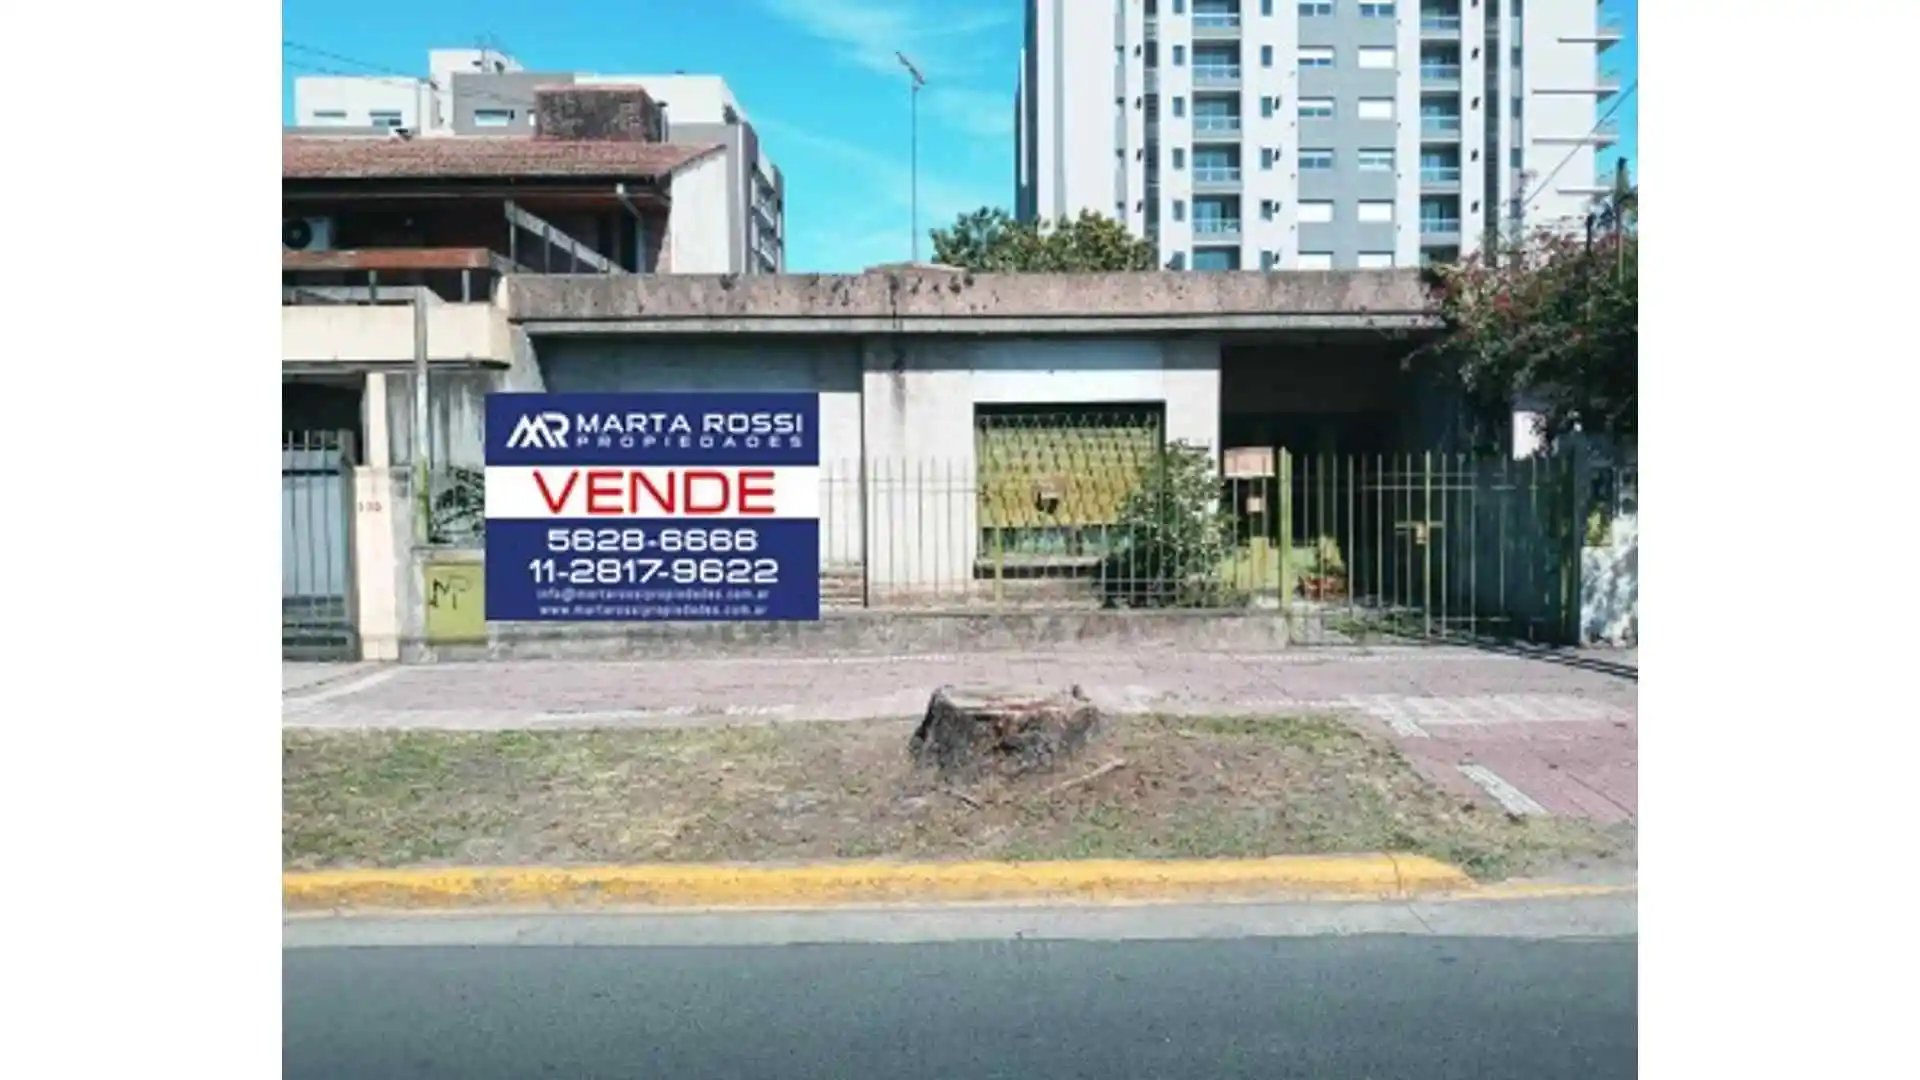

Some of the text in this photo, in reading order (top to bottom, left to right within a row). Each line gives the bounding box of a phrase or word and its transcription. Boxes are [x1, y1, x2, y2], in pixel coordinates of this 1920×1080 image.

[577, 413, 803, 433] MARTA ROSSI
[577, 435, 802, 448] PROPIEDADES
[533, 470, 775, 514] VENDE
[548, 528, 758, 551] 5628-6666
[529, 558, 778, 583] 11-2817-9622
